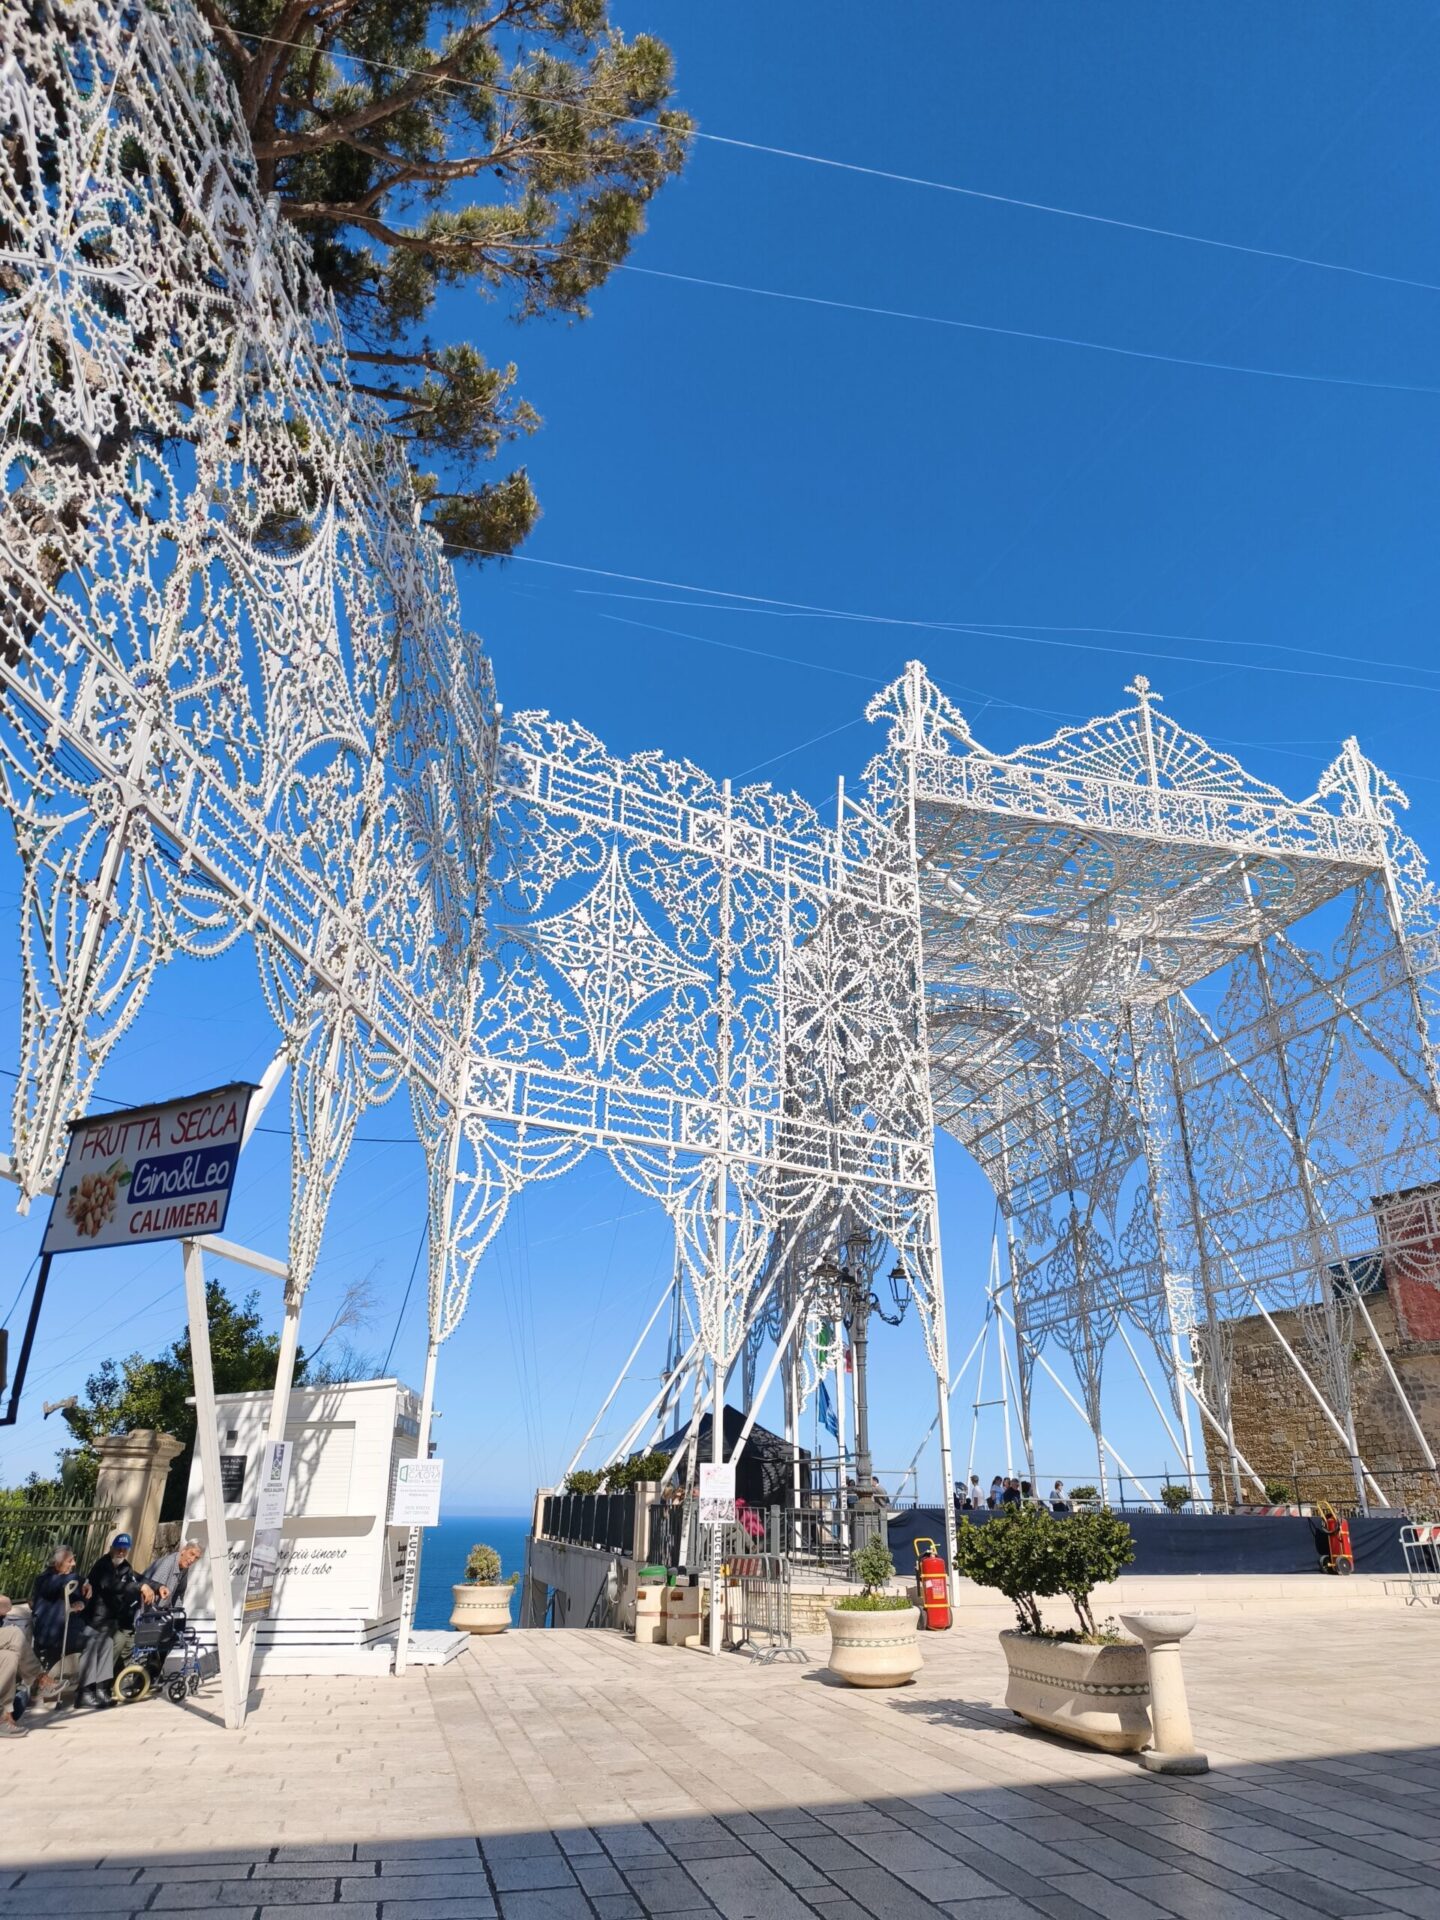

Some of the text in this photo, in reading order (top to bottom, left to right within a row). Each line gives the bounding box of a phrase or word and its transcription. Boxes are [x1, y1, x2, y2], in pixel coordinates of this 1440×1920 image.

[80, 1102, 237, 1160] FRUTTA SECCA
[133, 1154, 230, 1197] Gino&Leo
[129, 1199, 218, 1234] CALIMERA
[311, 1548, 347, 1560] sincero
[312, 1563, 332, 1575] cibo
[404, 1534, 418, 1593] LUCERNA
